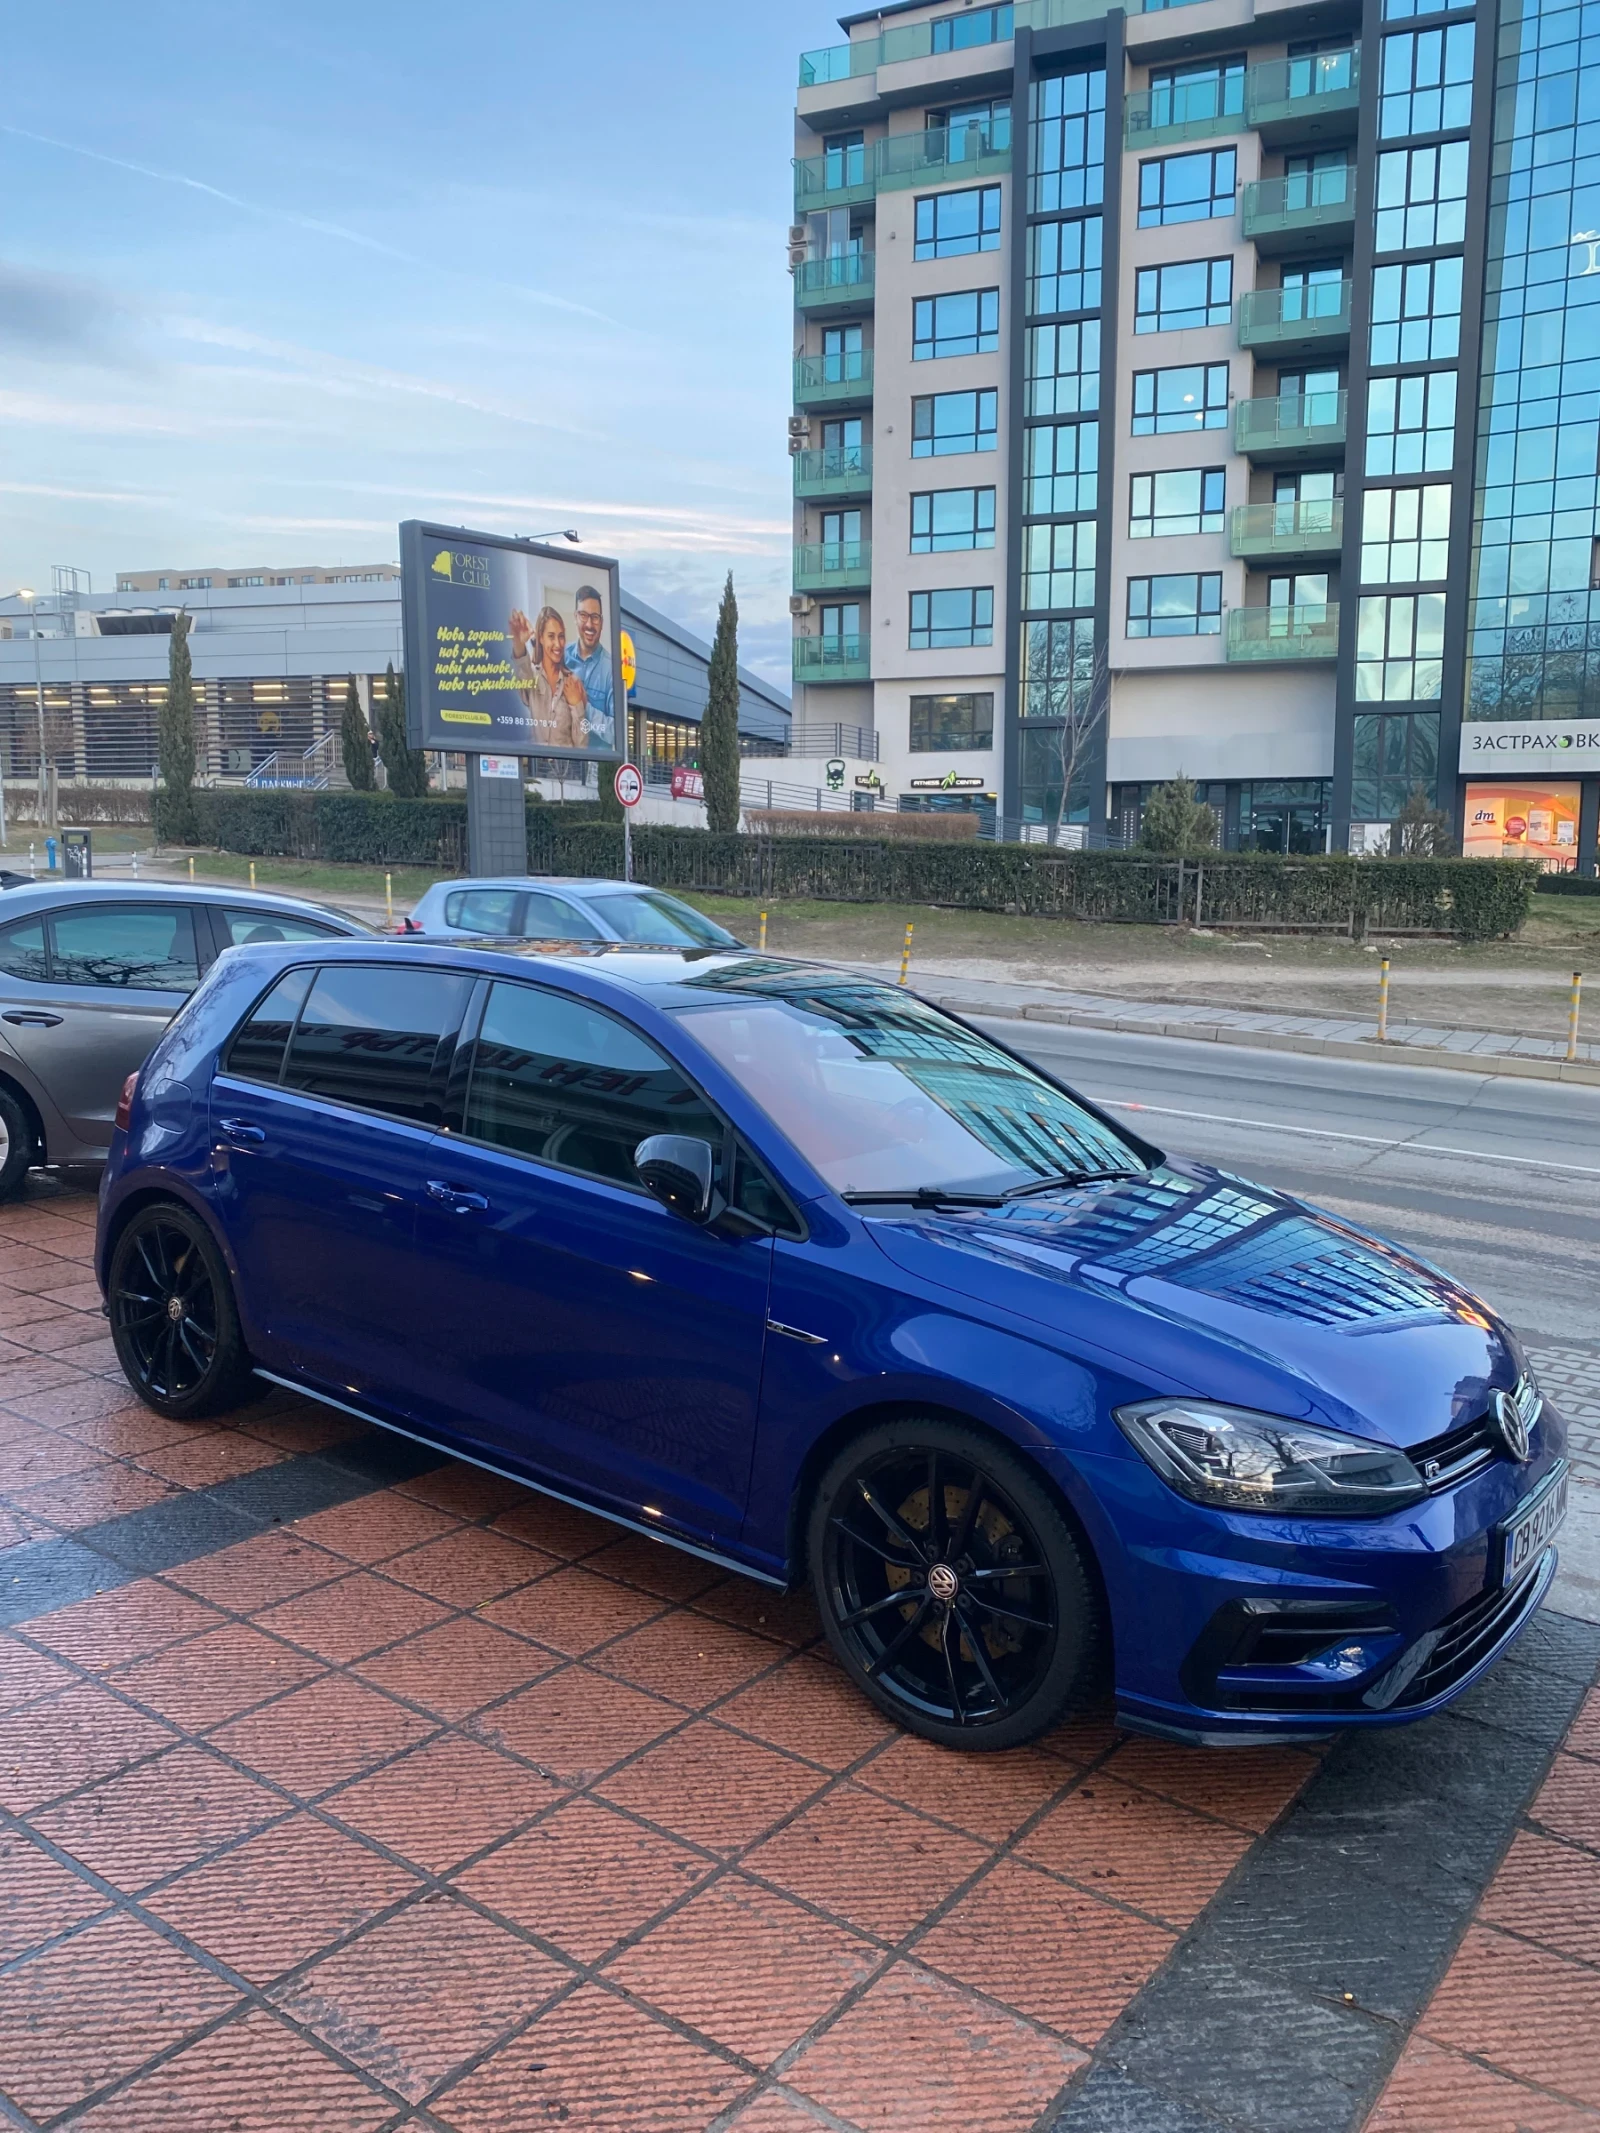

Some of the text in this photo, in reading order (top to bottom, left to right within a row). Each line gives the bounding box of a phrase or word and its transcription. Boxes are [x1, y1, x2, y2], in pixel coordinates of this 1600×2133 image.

[451, 552, 490, 571] FOREST
[463, 569, 490, 587] CLUB
[437, 626, 465, 641] Нова
[467, 630, 504, 646] година
[439, 644, 489, 663] нов дом,
[435, 660, 514, 675] нови планове,
[438, 676, 539, 695] ново изживяване!
[496, 715, 514, 725] +359
[514, 717, 524, 726] 88
[1475, 810, 1494, 821] dm
[1513, 1521, 1530, 1568] CB
[1532, 1492, 1555, 1550] 9216
